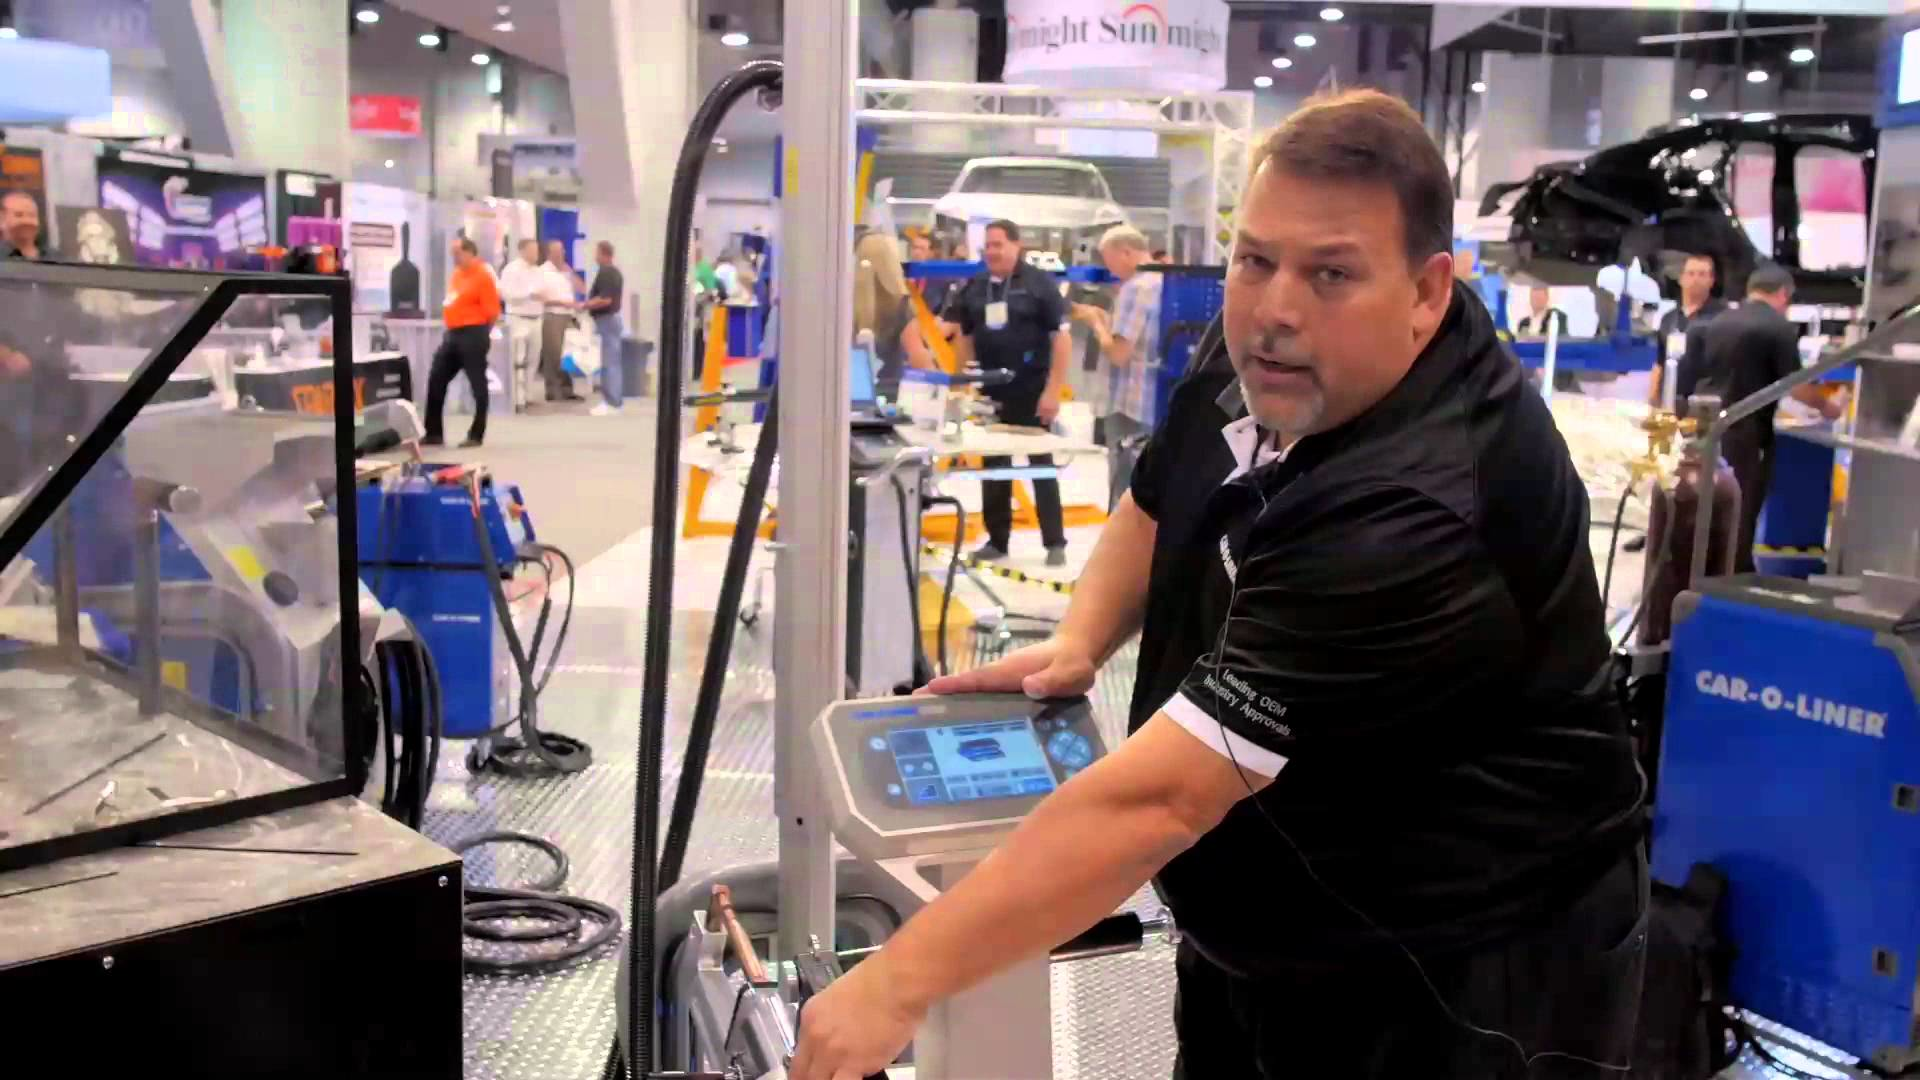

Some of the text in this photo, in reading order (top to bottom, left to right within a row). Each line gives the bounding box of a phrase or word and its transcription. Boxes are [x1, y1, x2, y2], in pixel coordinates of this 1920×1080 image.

[1223, 668, 1287, 717] Leading OEM
[1695, 669, 1888, 738] CAR-O-LINER
[1240, 702, 1291, 736] Approvals
